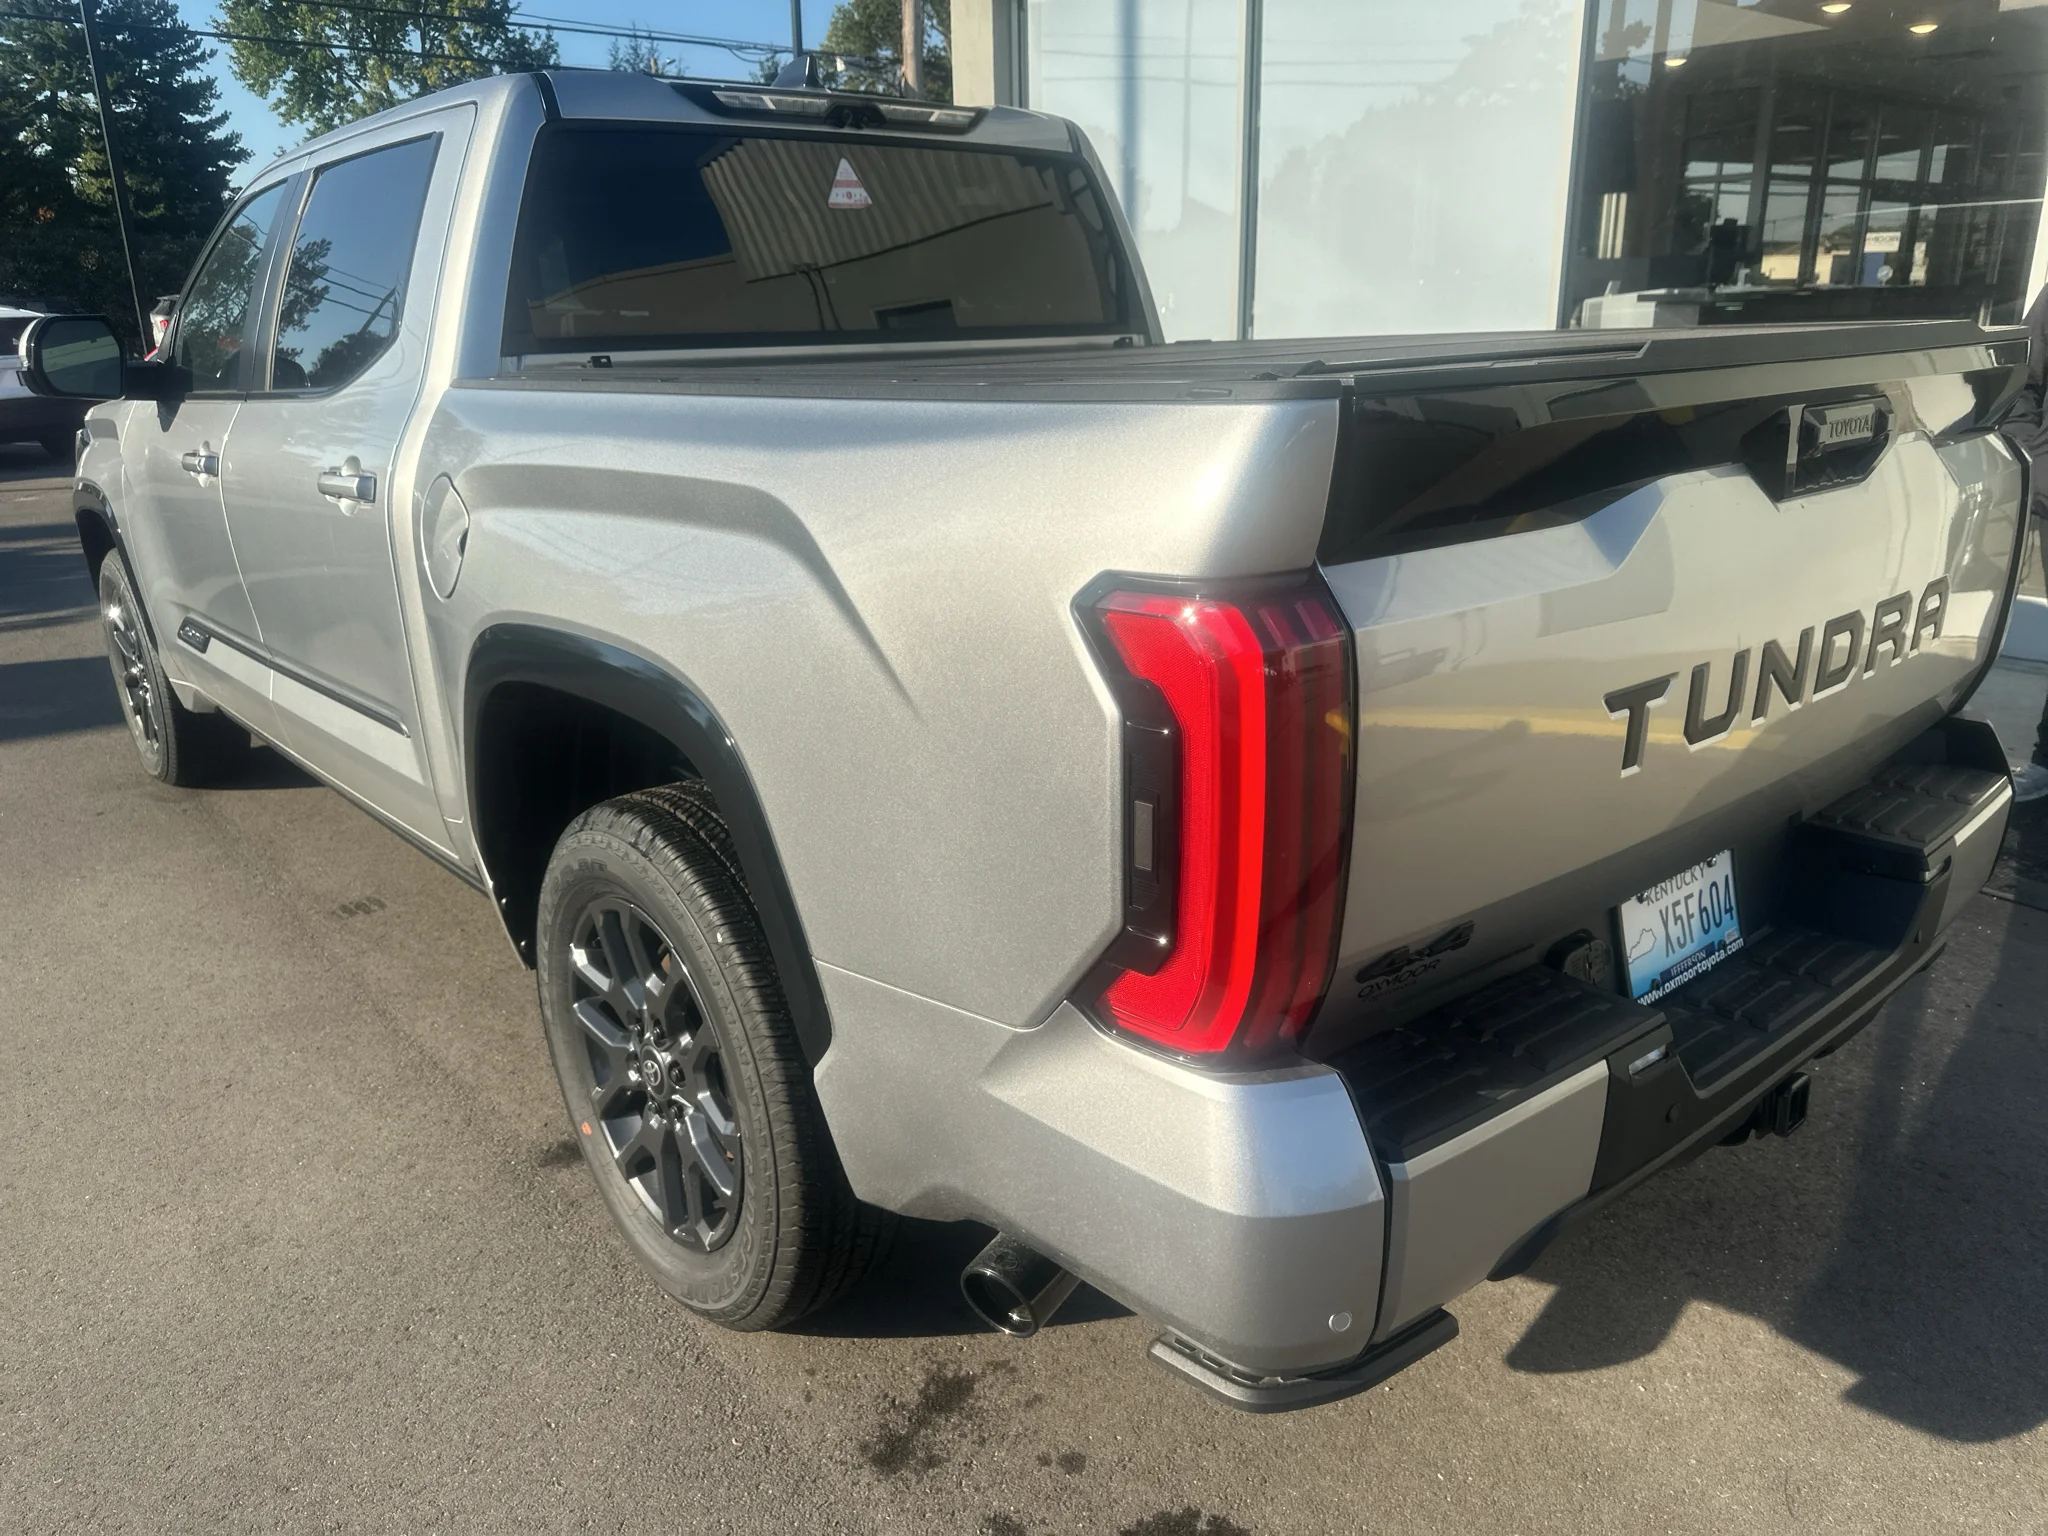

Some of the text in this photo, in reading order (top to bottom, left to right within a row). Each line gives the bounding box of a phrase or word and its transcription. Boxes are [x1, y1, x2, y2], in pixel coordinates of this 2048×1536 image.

[1829, 415, 1870, 438] TOYOTA
[1602, 574, 1950, 778] TUNDRA
[1645, 861, 1706, 906] KENTUCKY
[1658, 873, 1734, 958] X5F604
[1637, 937, 1744, 1006] www.oxmoortoyota.com
